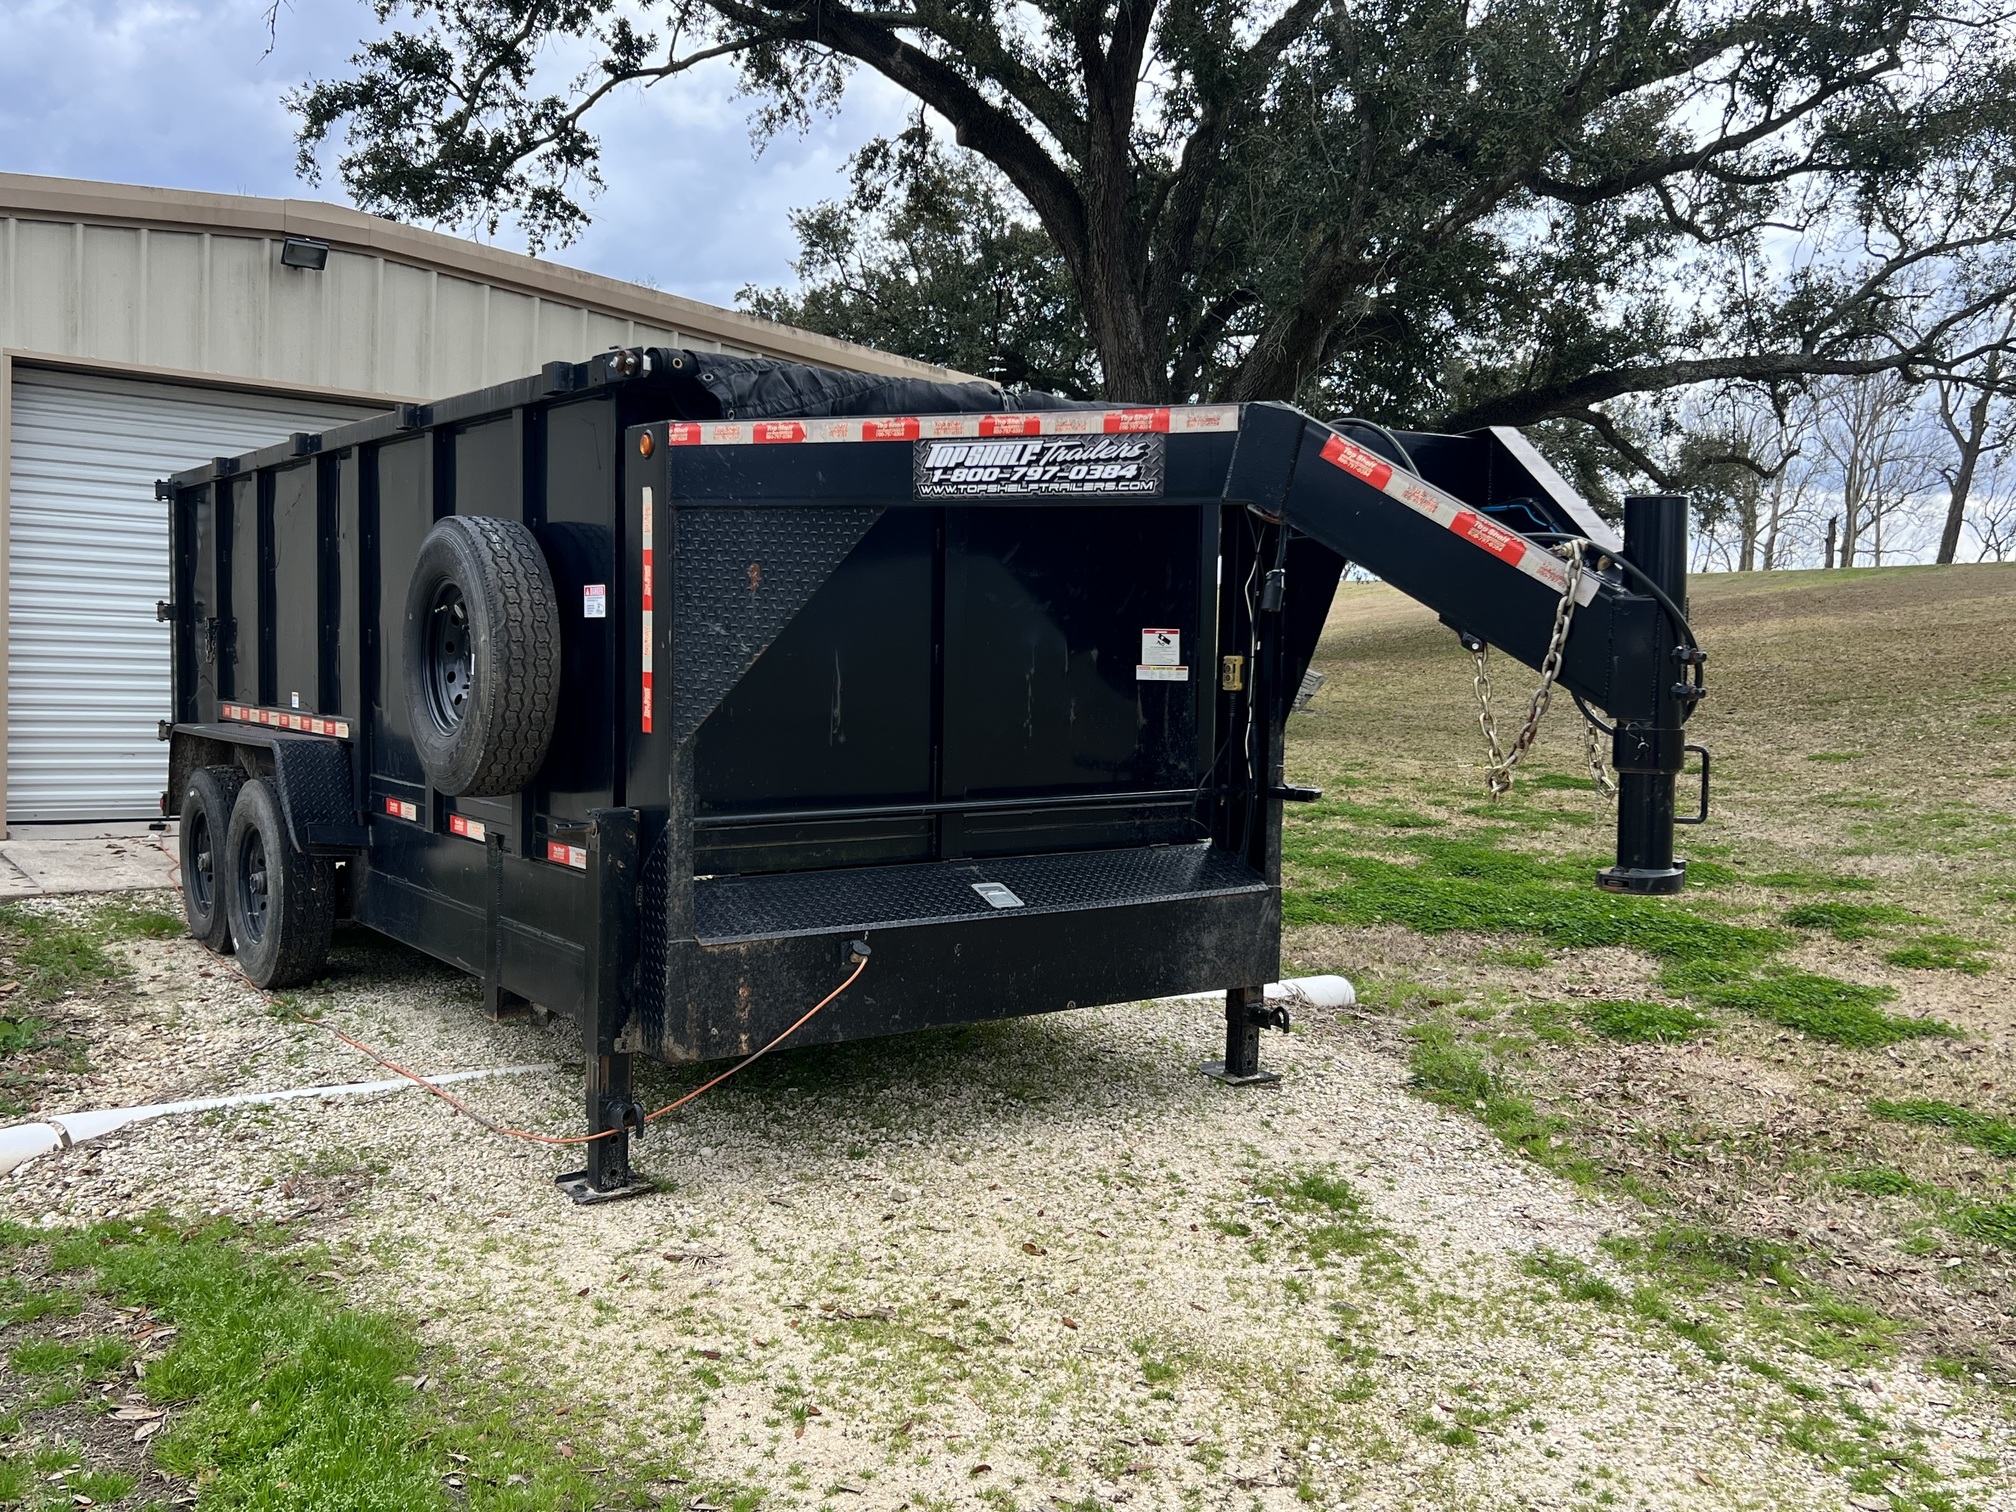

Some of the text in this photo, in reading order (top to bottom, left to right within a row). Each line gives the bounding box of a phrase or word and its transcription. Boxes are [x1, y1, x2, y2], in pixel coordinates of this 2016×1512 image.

[924, 438, 1147, 468] TOPSHELF Trailers
[931, 464, 1138, 483] 1-800-797-0384
[920, 480, 1155, 495] WWW.TOPSHELFTRAILERS.COM
